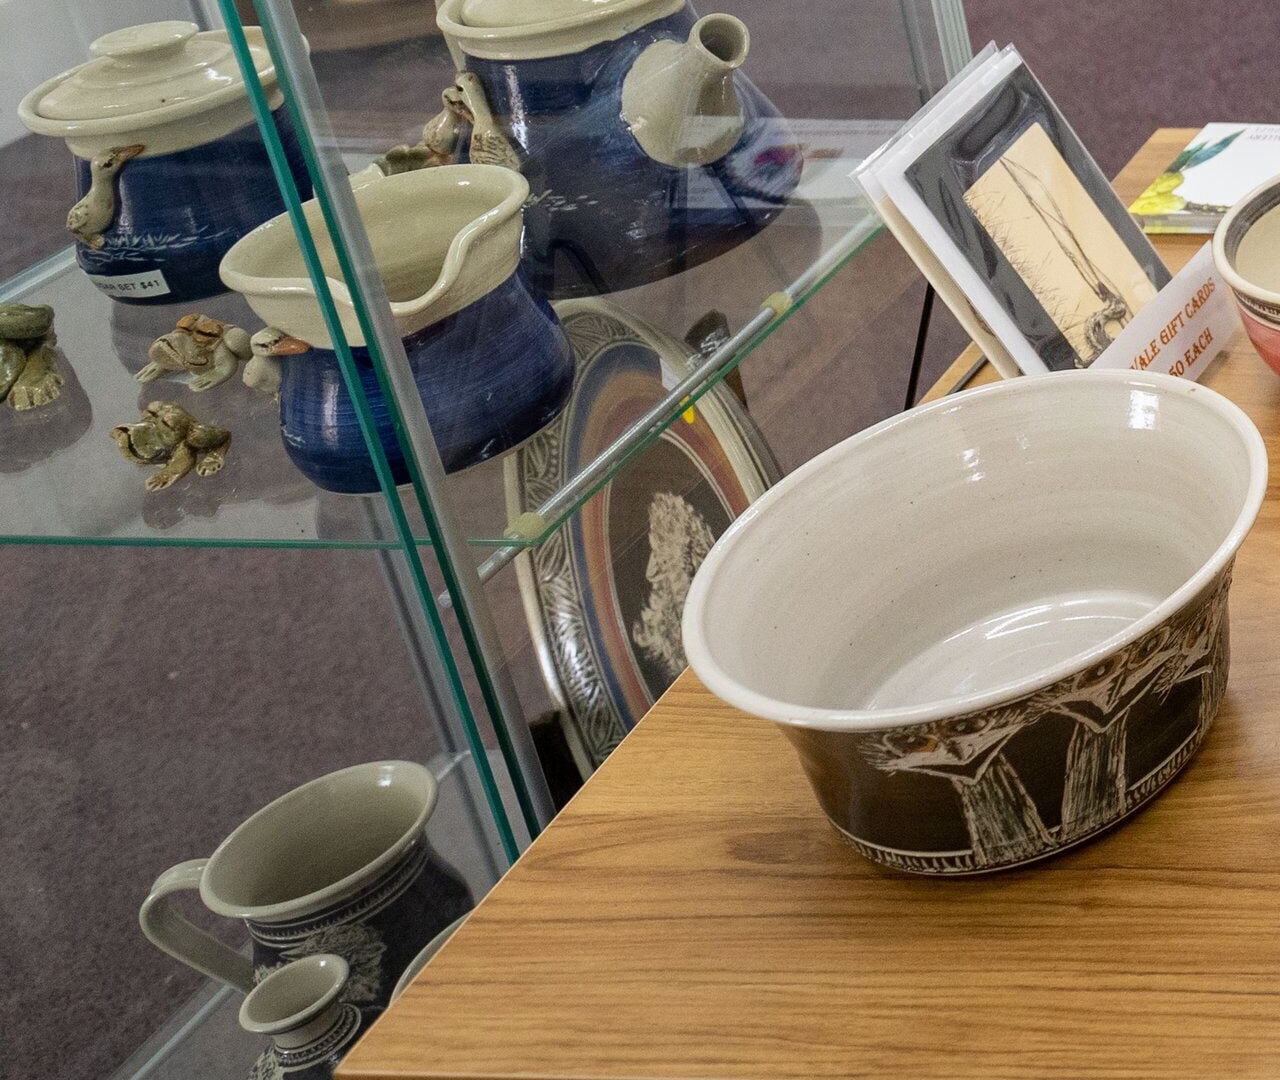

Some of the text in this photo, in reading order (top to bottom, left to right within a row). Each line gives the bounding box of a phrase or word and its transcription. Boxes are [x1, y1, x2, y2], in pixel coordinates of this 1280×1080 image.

[117, 282, 137, 292] SET
[140, 280, 160, 290] $41
[1159, 311, 1185, 346] GIFT
[1184, 278, 1217, 318] CARDS
[1184, 326, 1215, 366] EACH
